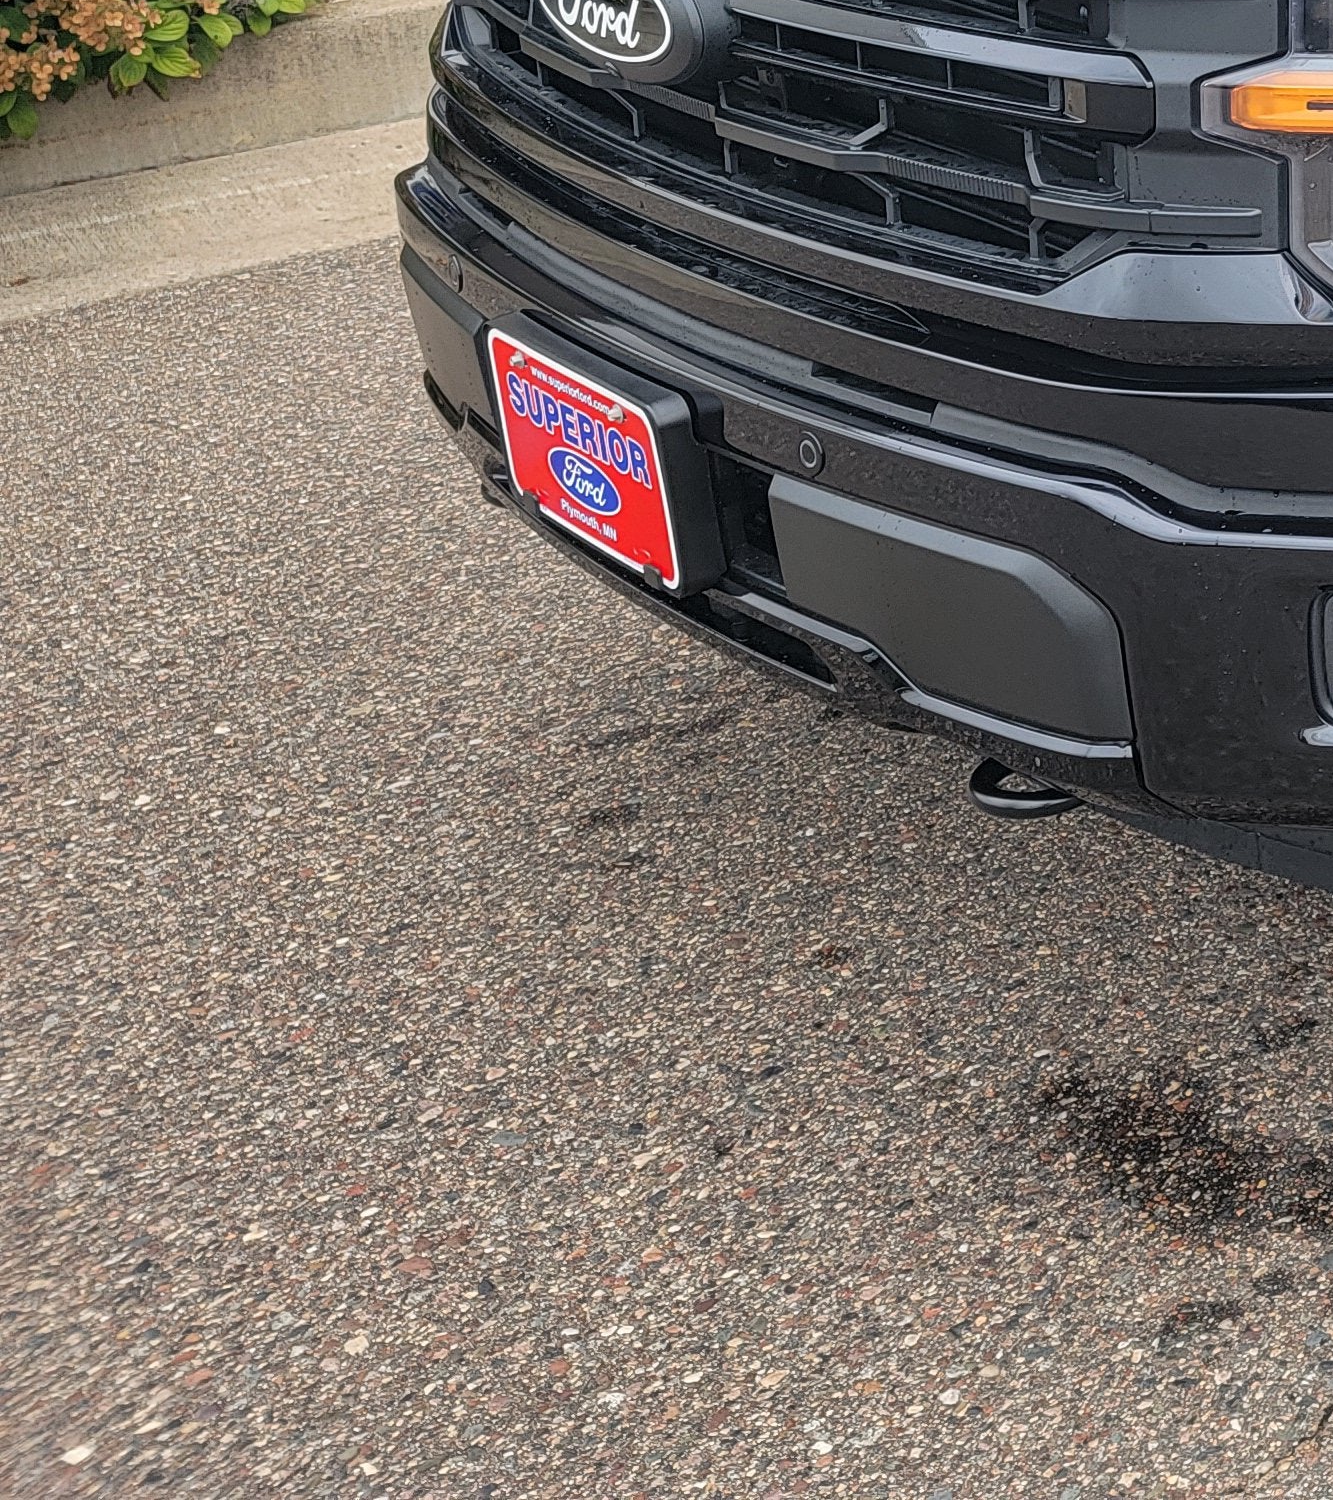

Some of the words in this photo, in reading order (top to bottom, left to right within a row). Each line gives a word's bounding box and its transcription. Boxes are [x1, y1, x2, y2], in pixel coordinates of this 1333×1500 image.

[506, 371, 653, 490] SUPERIOR
[560, 497, 603, 535] Plymouth,
[602, 522, 618, 542] MN
